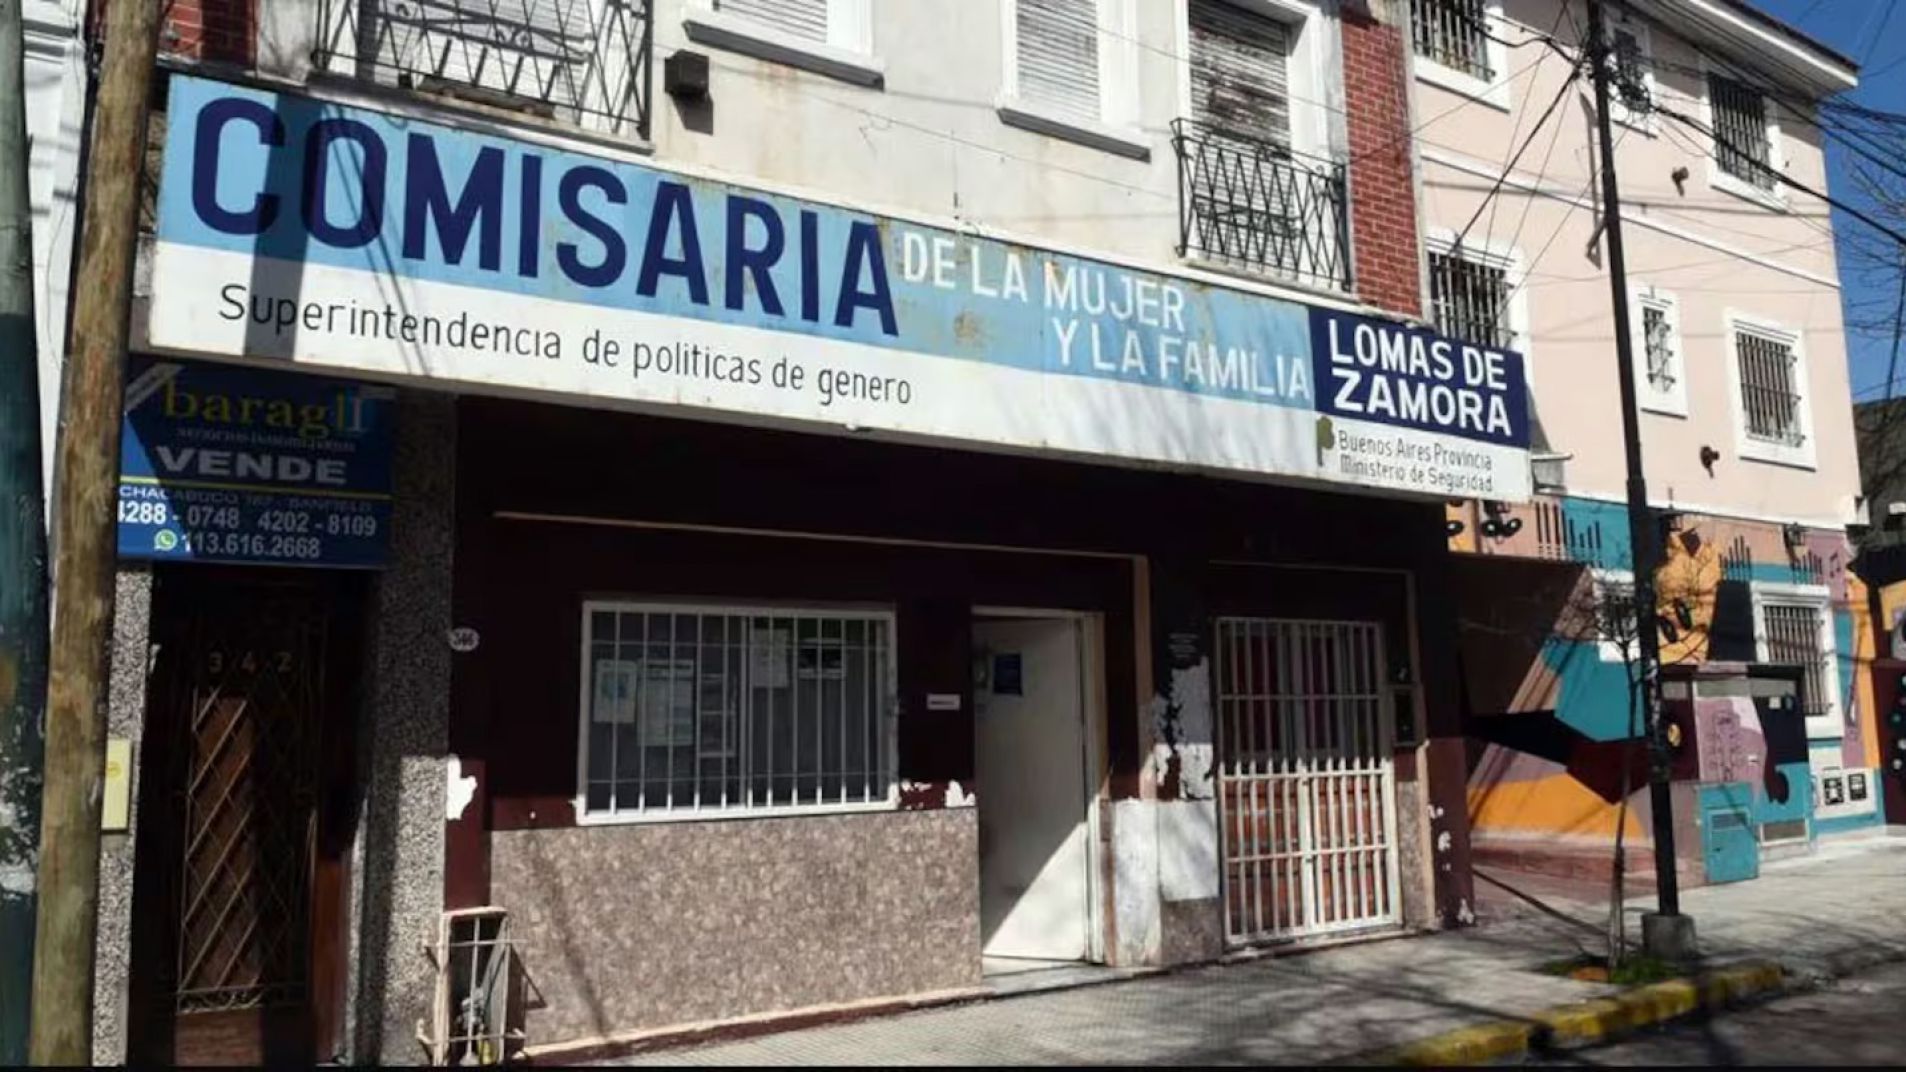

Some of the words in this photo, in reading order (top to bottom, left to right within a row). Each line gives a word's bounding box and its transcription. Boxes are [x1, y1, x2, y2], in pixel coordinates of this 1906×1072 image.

[192, 97, 899, 337] COMISARIA
[904, 232, 957, 289] DE
[970, 244, 1028, 303] LA
[1044, 261, 1185, 332] MUJER
[218, 283, 561, 359] Superintendencia
[583, 328, 620, 368] de
[634, 342, 762, 384] politicas
[772, 357, 805, 391] de
[818, 368, 912, 406] genero
[1052, 317, 1080, 367] Y
[1092, 322, 1148, 376] LA
[1159, 336, 1312, 400] FAMILIA
[1329, 319, 1454, 381] LOMAS
[1462, 345, 1508, 391] DE
[1331, 366, 1512, 437] ZAMORA
[156, 445, 348, 485] VENDE
[1338, 430, 1392, 457] Buenos
[1397, 437, 1431, 462] Aires
[1434, 442, 1492, 471] Provincia
[1340, 453, 1406, 481] Ministerio
[1410, 464, 1425, 483] de
[1428, 467, 1493, 492] Seguridad
[187, 505, 240, 531] 0748
[257, 509, 310, 533] 4202
[328, 513, 377, 537] 8109
